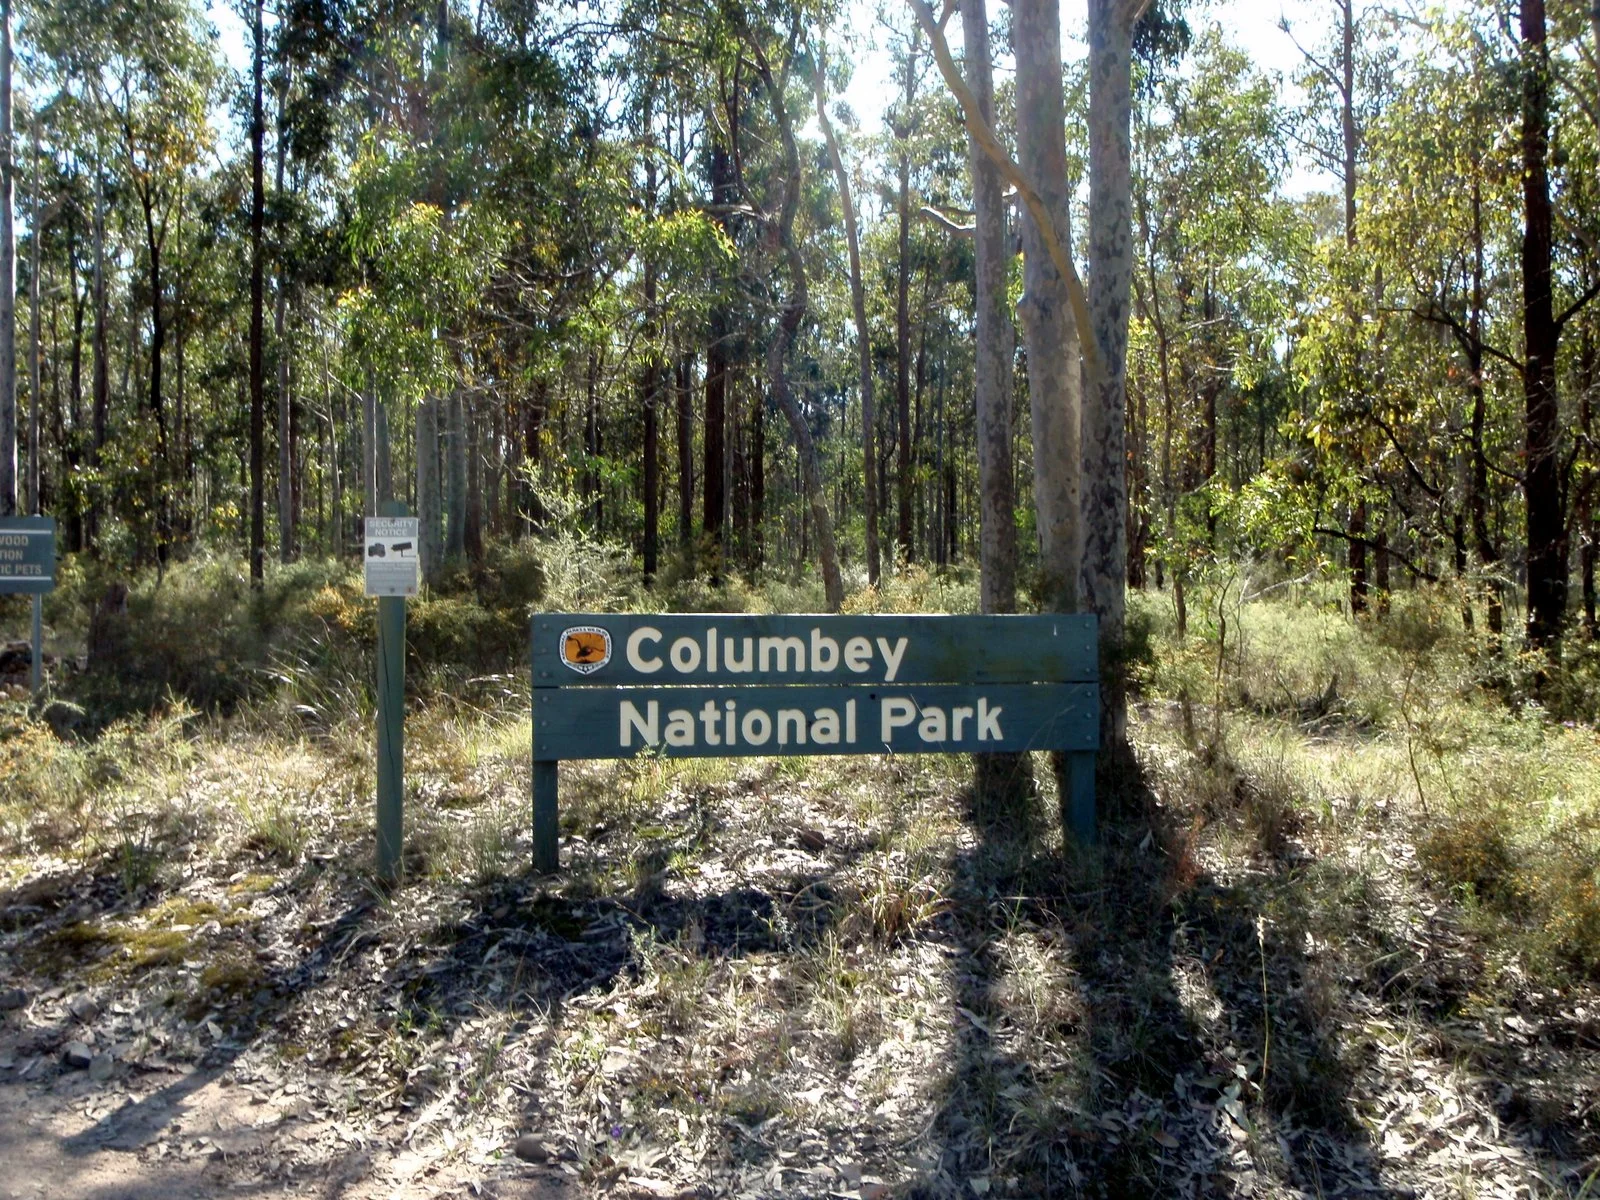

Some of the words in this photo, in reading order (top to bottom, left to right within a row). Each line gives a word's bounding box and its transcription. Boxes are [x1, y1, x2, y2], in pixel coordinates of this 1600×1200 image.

[375, 528, 408, 536] NOTICE
[15, 564, 42, 575] PETS
[625, 626, 909, 682] Columbey
[619, 698, 856, 747] National
[880, 697, 1004, 743] Park
